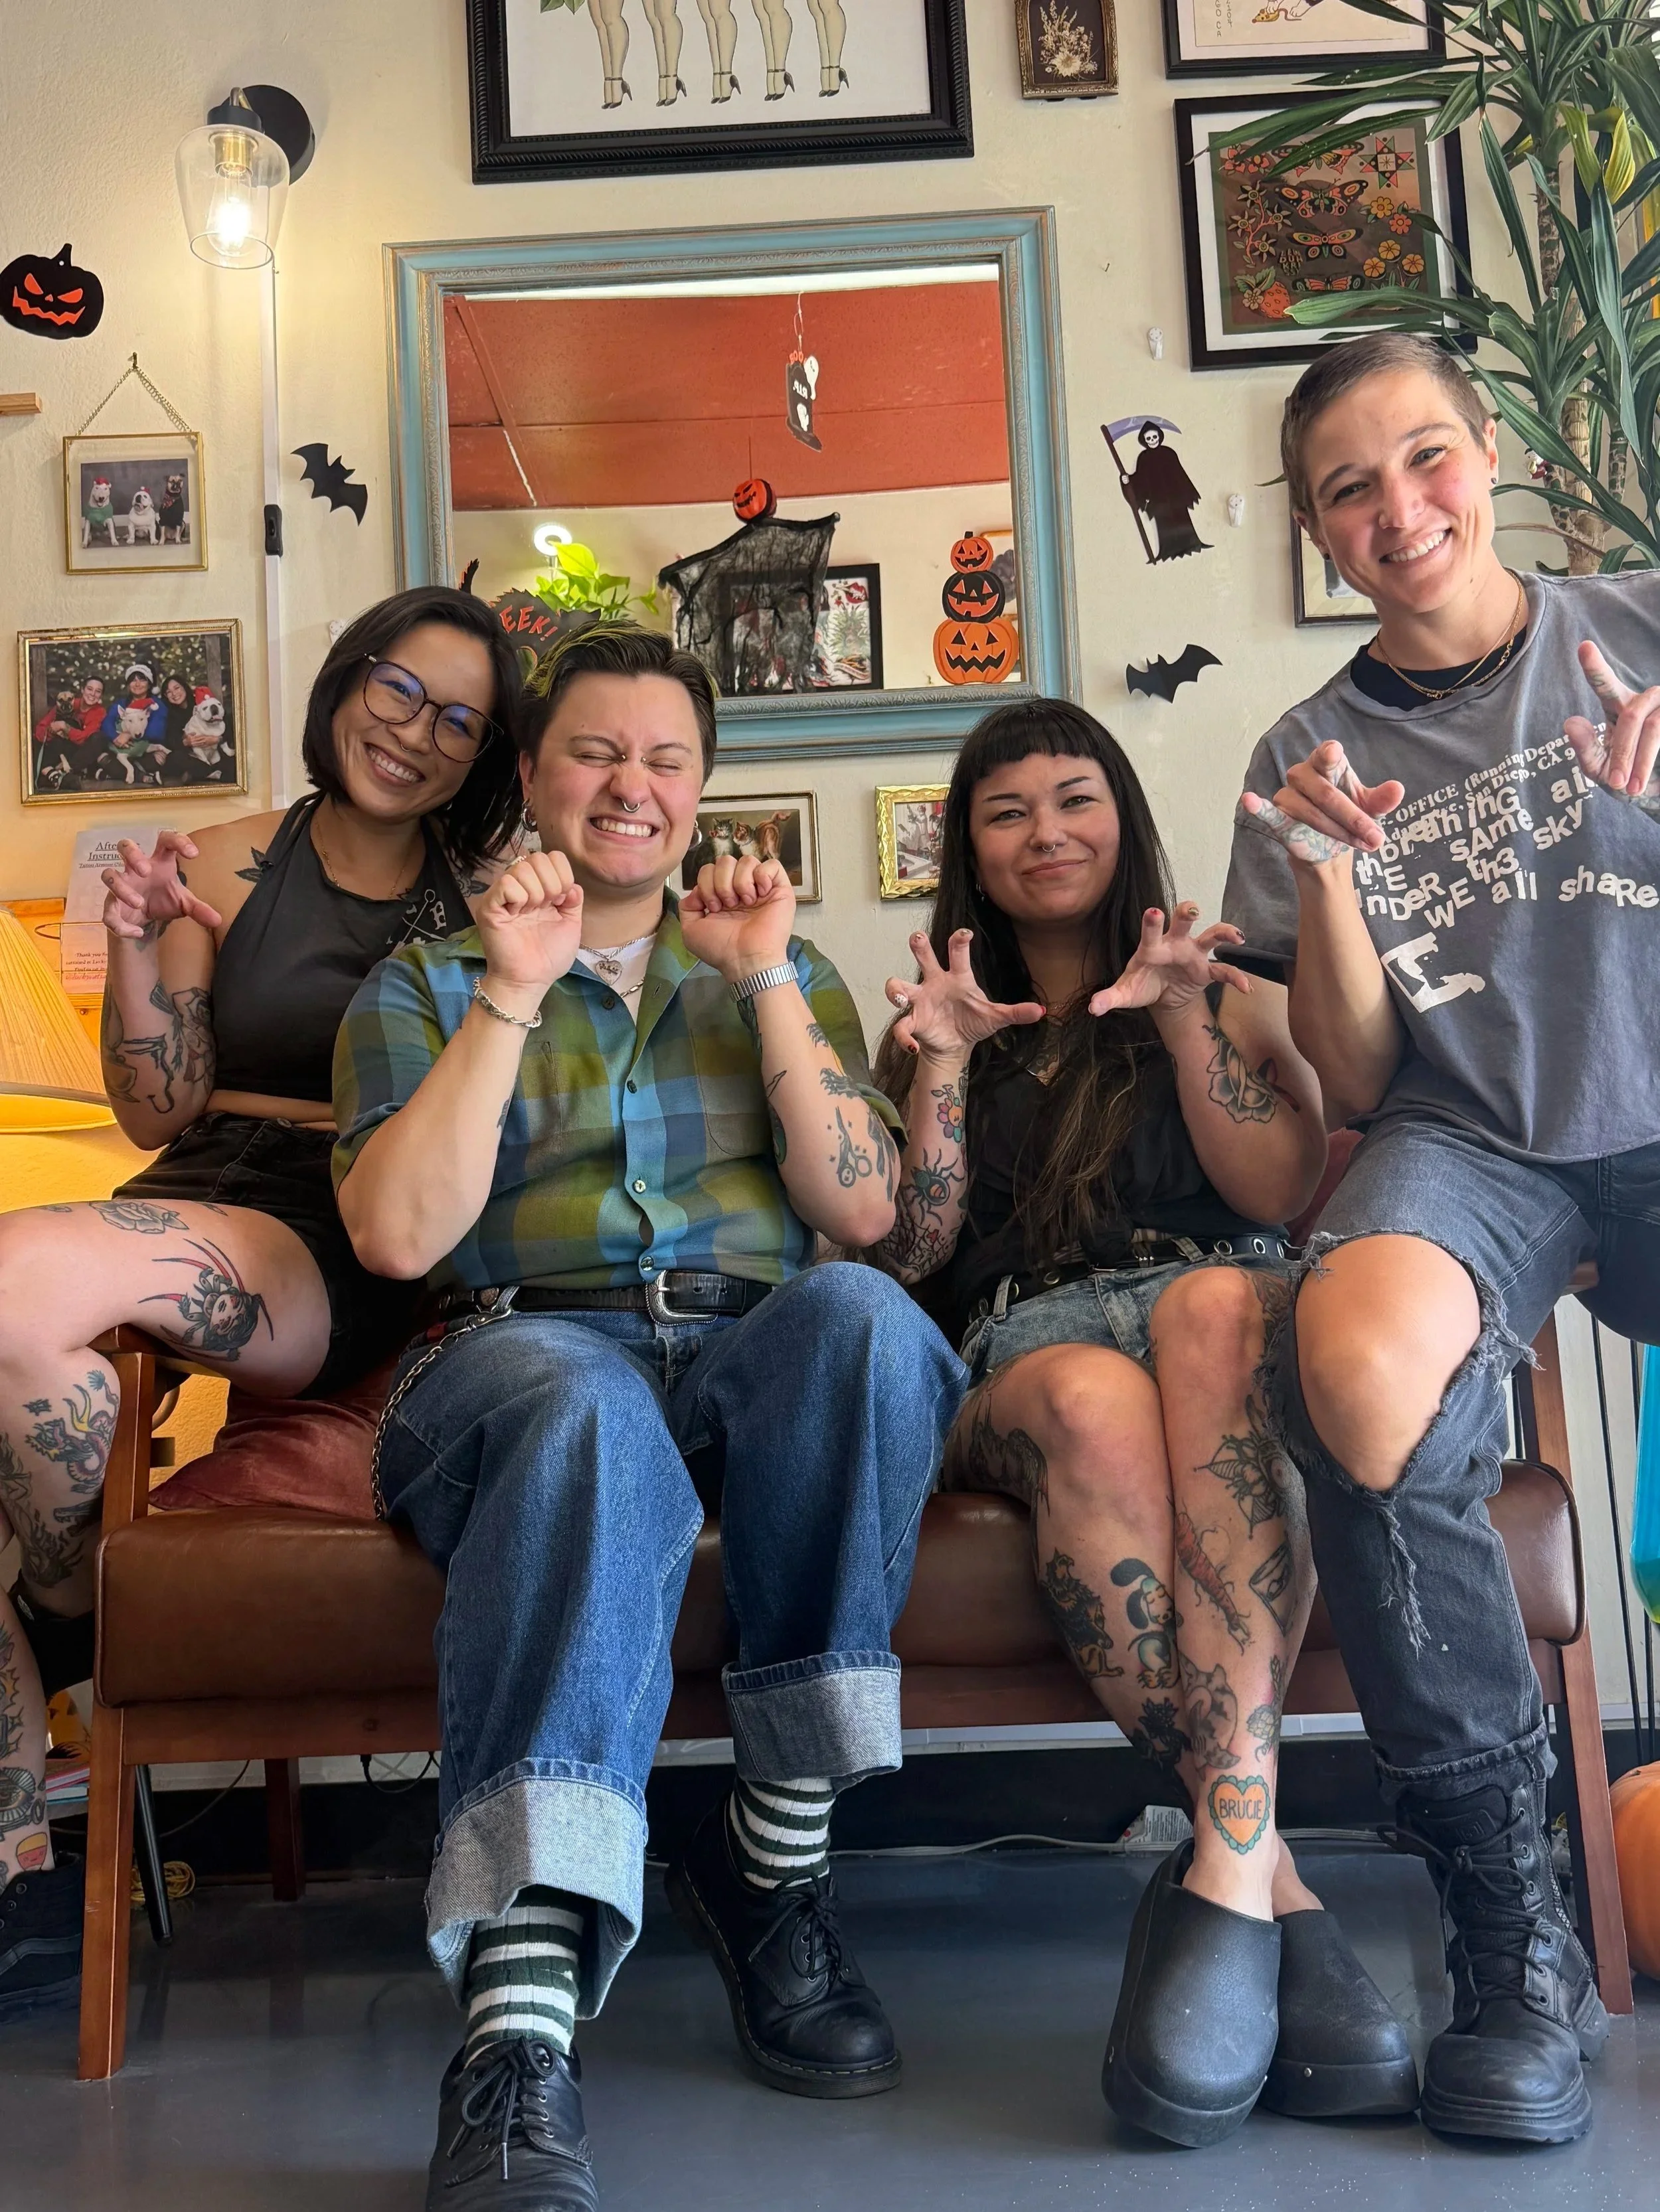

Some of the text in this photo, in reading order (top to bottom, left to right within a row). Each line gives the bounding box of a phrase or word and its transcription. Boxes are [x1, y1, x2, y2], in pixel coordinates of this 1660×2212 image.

[499, 605, 558, 642] EEK!
[1537, 751, 1563, 771] CA
[1533, 798, 1584, 850] sky
[1491, 871, 1538, 904] all
